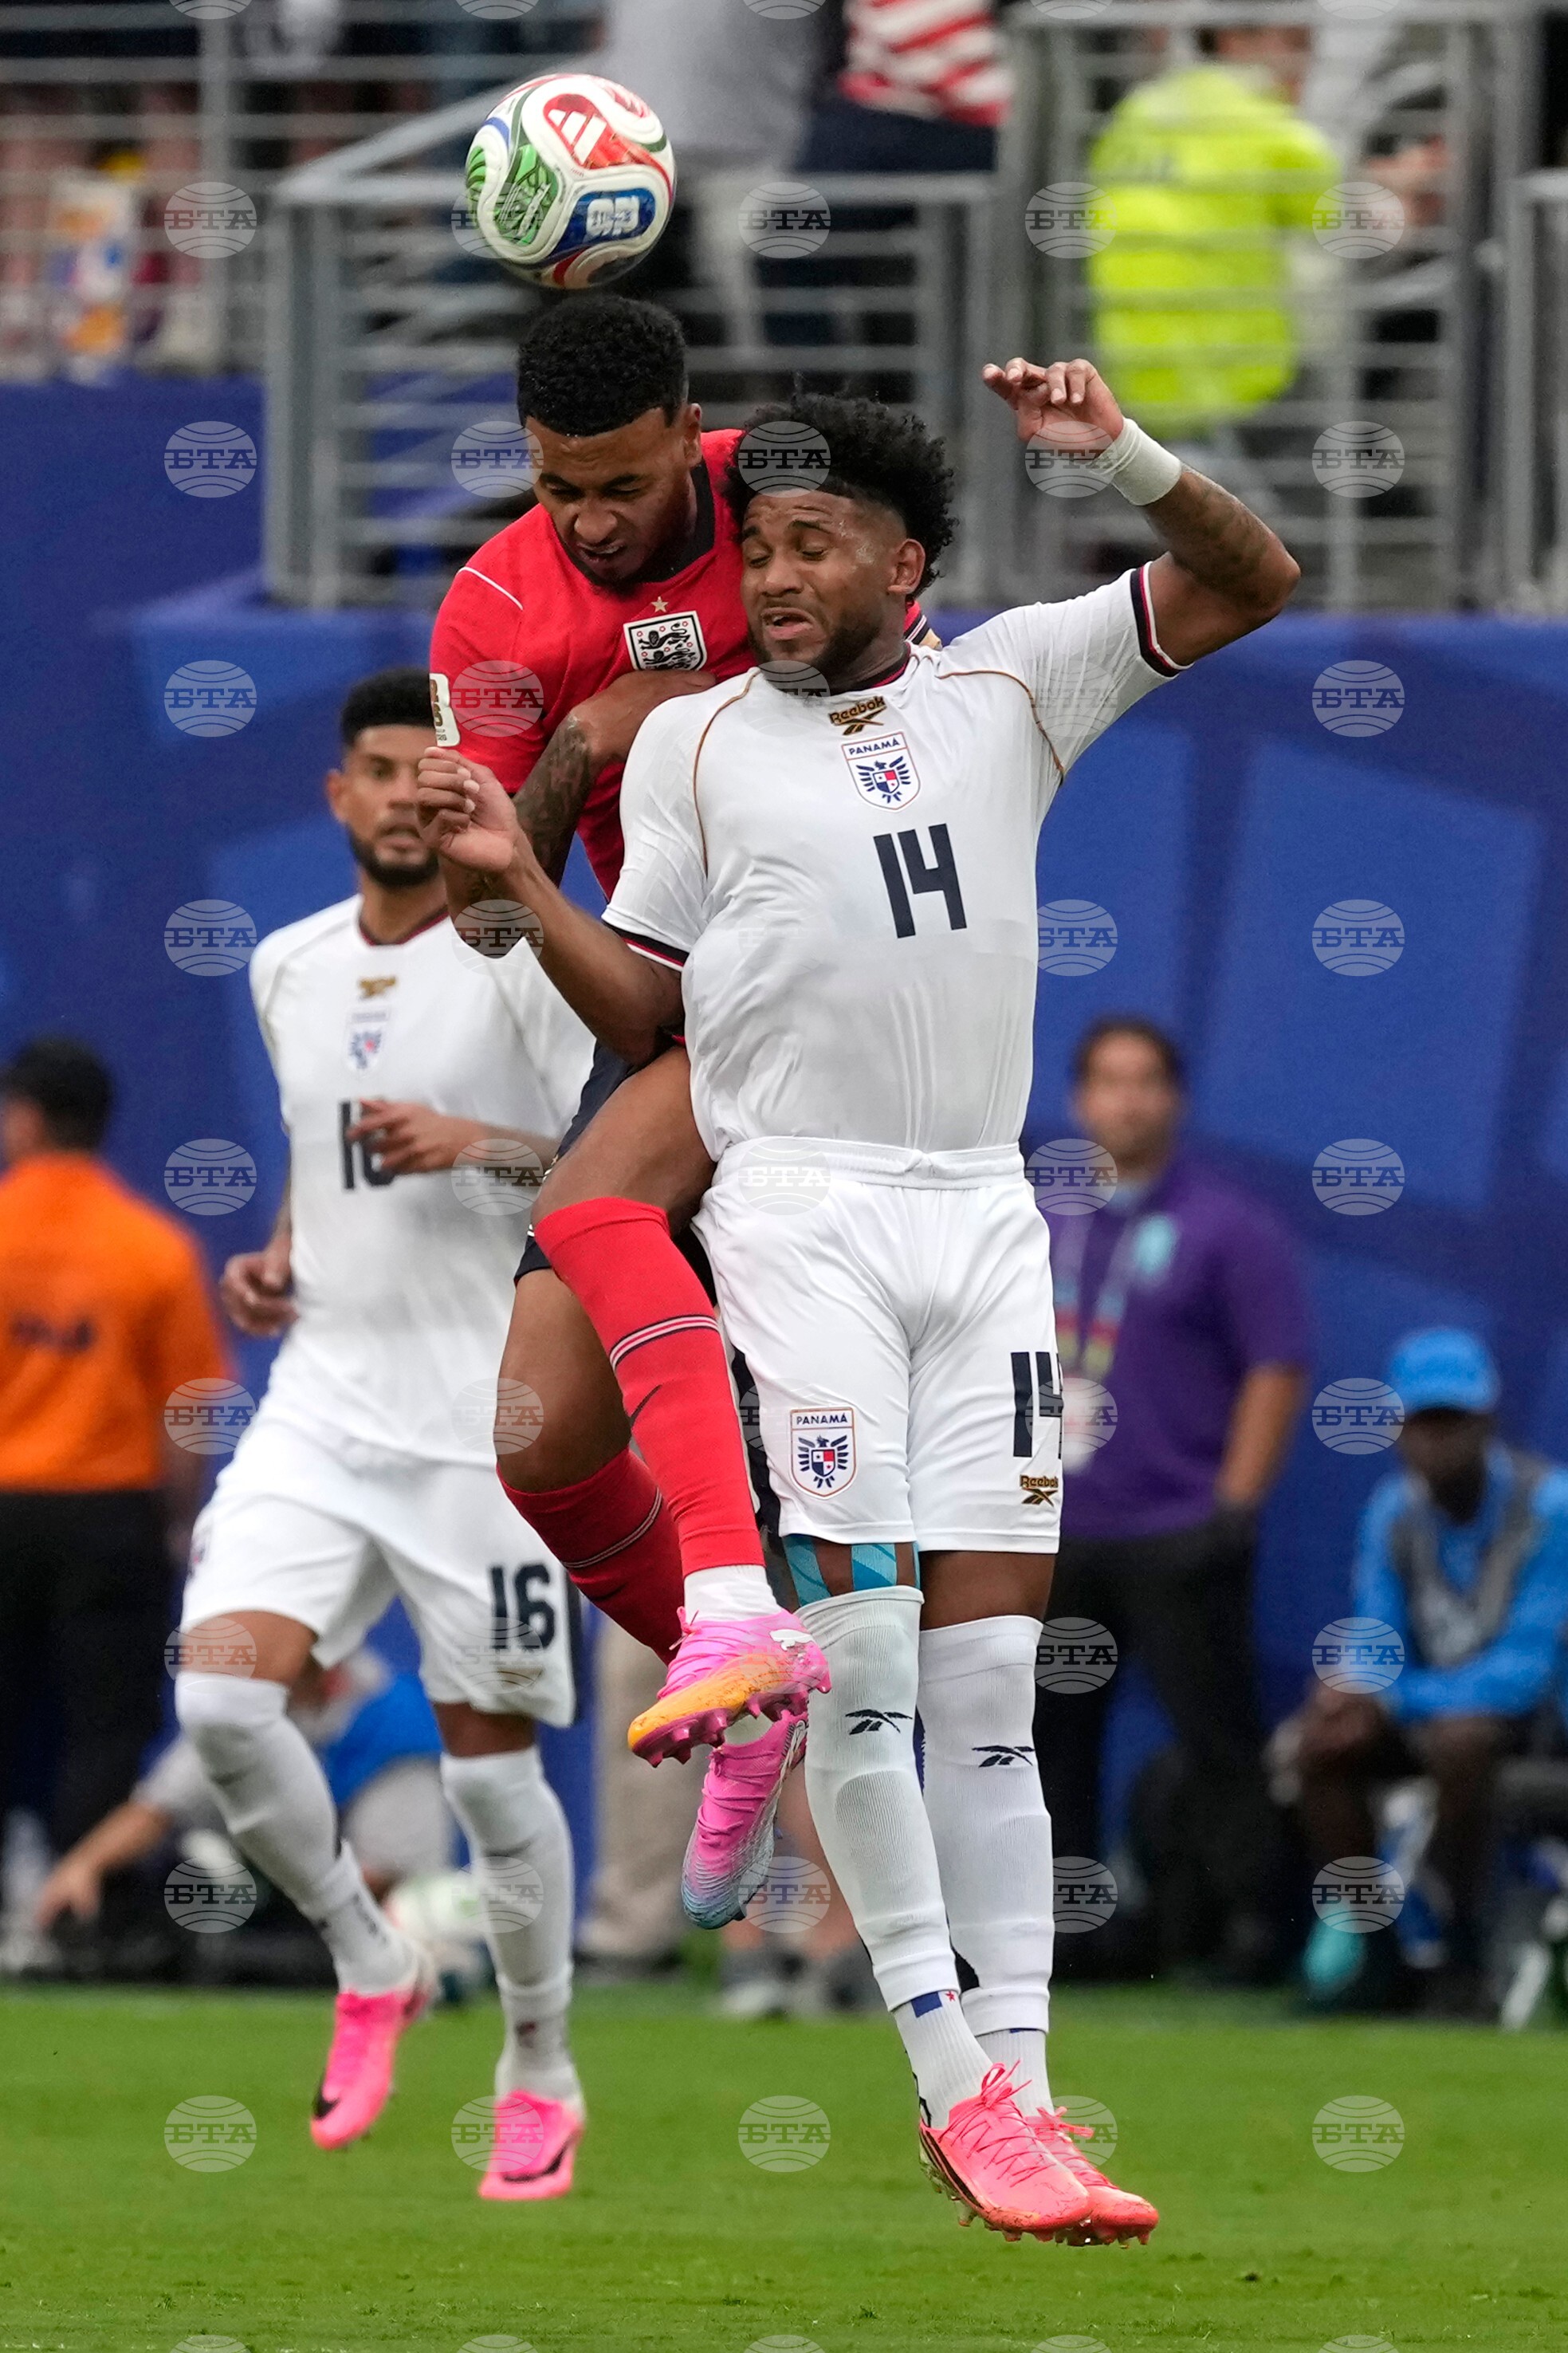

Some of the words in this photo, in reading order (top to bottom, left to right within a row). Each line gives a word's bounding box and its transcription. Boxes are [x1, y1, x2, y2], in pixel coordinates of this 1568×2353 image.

[828, 696, 886, 726] Reebok
[873, 823, 967, 939] 14
[1020, 1476, 1059, 1489] Reebok
[490, 1564, 555, 1651] 16
